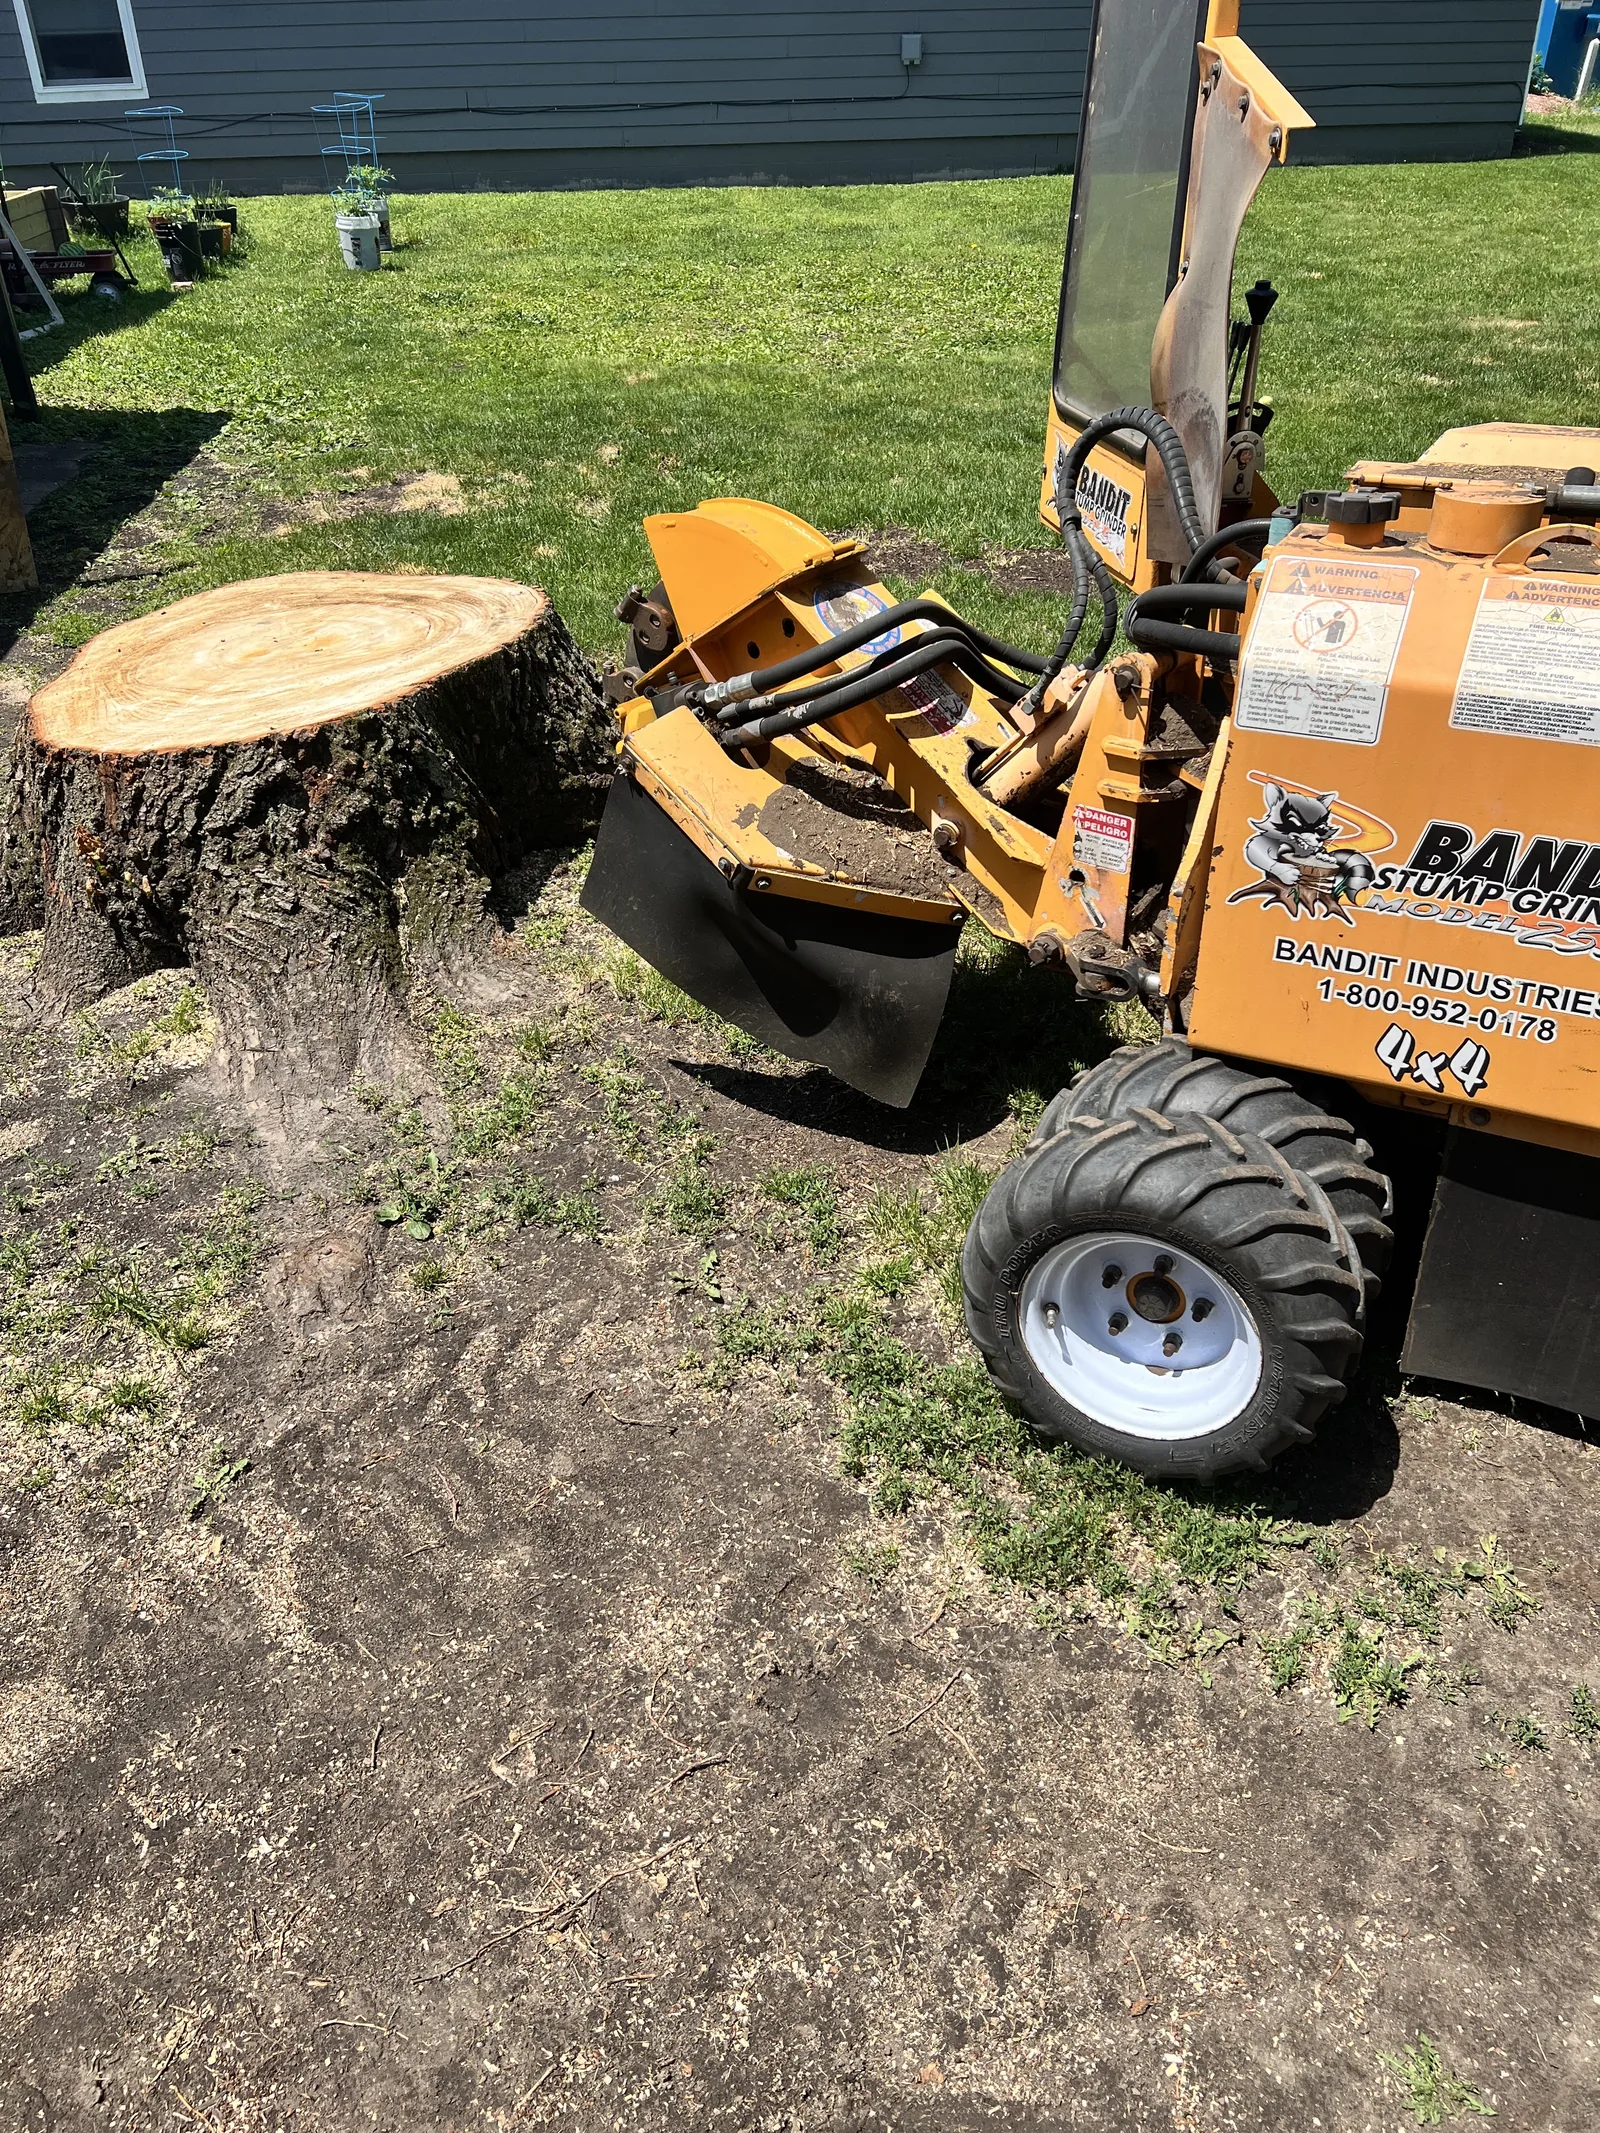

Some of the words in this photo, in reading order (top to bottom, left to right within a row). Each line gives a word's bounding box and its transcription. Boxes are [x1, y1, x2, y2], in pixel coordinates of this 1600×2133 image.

[53, 261, 86, 269] FLYER
[1079, 465, 1131, 521] BANDIT
[1095, 506, 1126, 538] GRINDER
[1314, 565, 1379, 580] WARNING
[1308, 584, 1405, 601] ADVERTENCIA
[1540, 582, 1600, 596] WARNING
[1506, 668, 1536, 676] PELIGRO
[1084, 821, 1128, 839] PELIGRO
[1085, 811, 1127, 828] DANGER
[1371, 867, 1504, 906] STUMP
[1363, 894, 1518, 934] MODEL
[1518, 922, 1600, 958] 25
[1275, 938, 1399, 980] BANDIT
[1319, 978, 1556, 1042] 1-800-952-0178
[1375, 1022, 1490, 1098] 4x4
[1000, 1223, 1062, 1286] POWER
